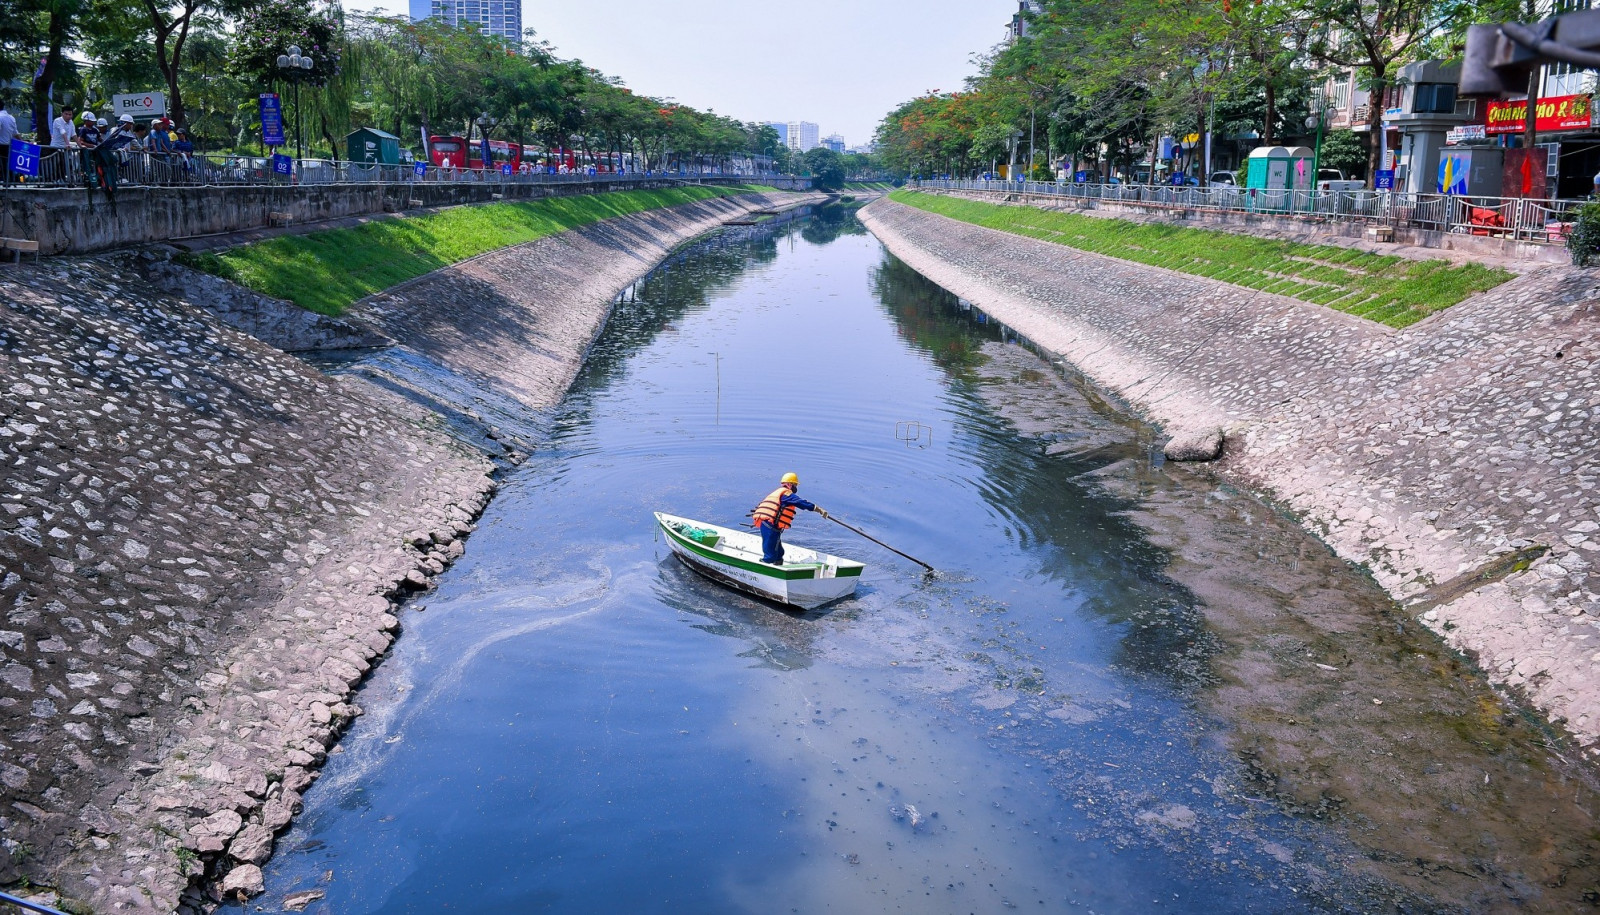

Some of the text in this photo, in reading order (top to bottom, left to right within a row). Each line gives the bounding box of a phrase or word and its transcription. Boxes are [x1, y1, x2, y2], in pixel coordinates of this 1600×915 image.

[1535, 100, 1555, 118] ÁO
[1557, 101, 1568, 118] &
[16, 155, 31, 168] 01
[277, 162, 287, 171] 02
[1379, 177, 1390, 185] 22
